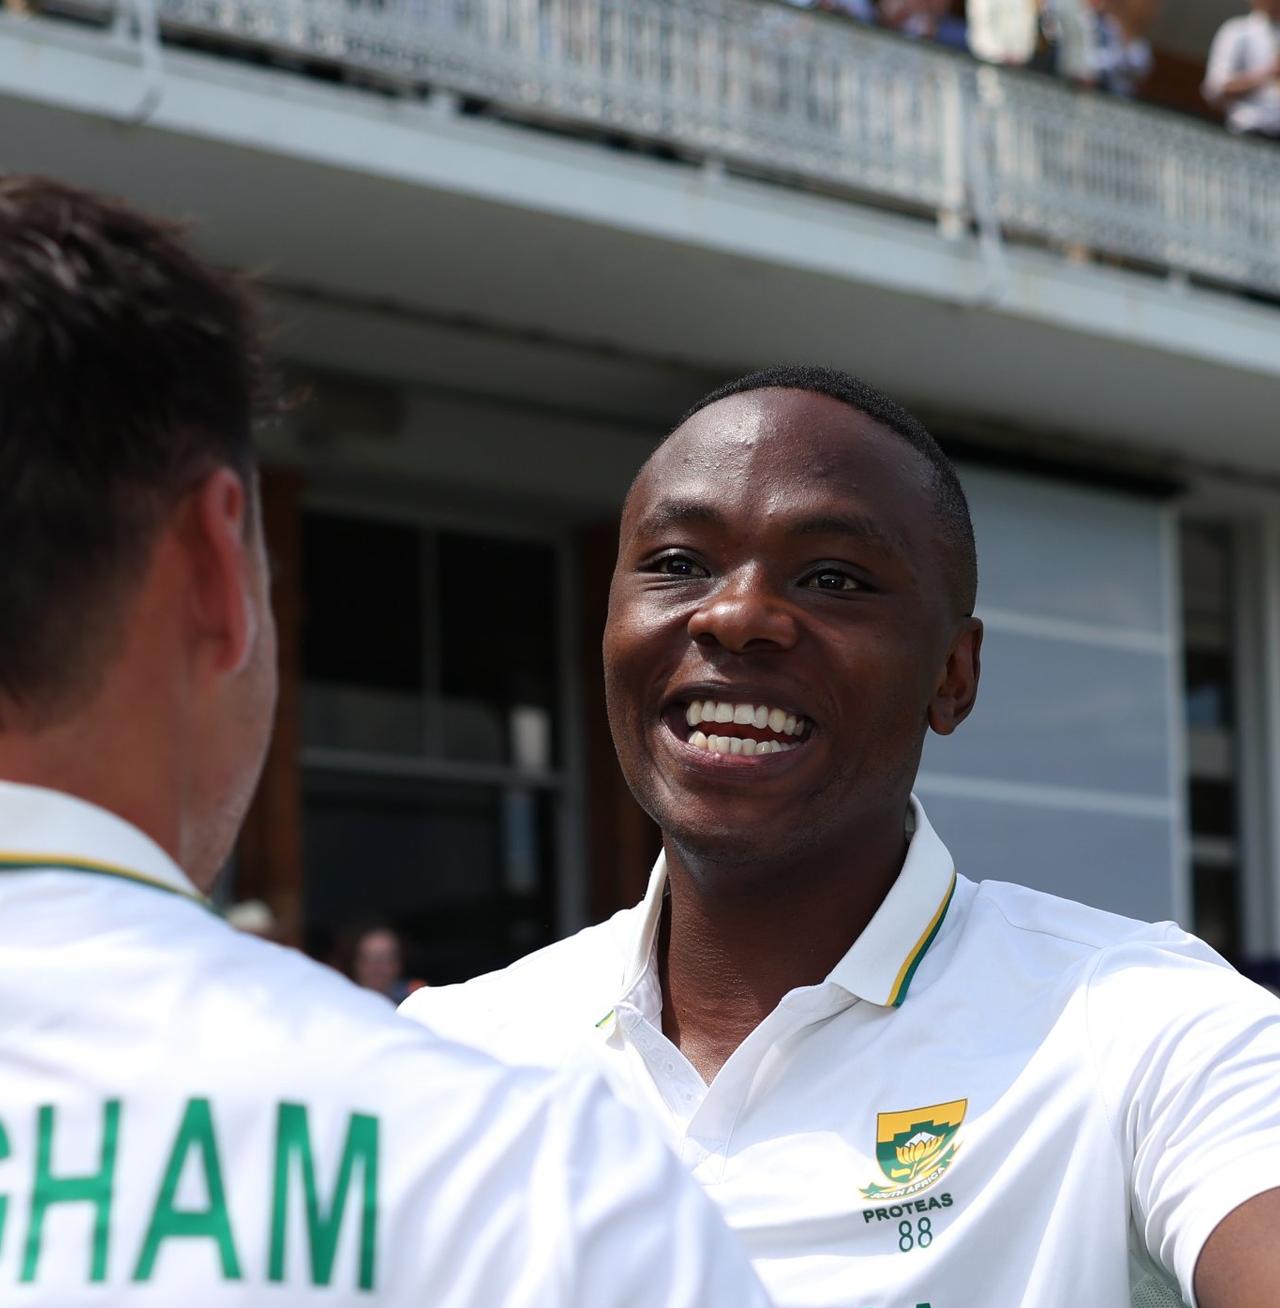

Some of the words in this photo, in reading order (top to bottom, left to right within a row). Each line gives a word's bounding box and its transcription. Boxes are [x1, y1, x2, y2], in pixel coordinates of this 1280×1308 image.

[906, 1167, 945, 1193] AFRICA
[862, 1192, 954, 1224] PROTEAS
[898, 1216, 933, 1252] 88
